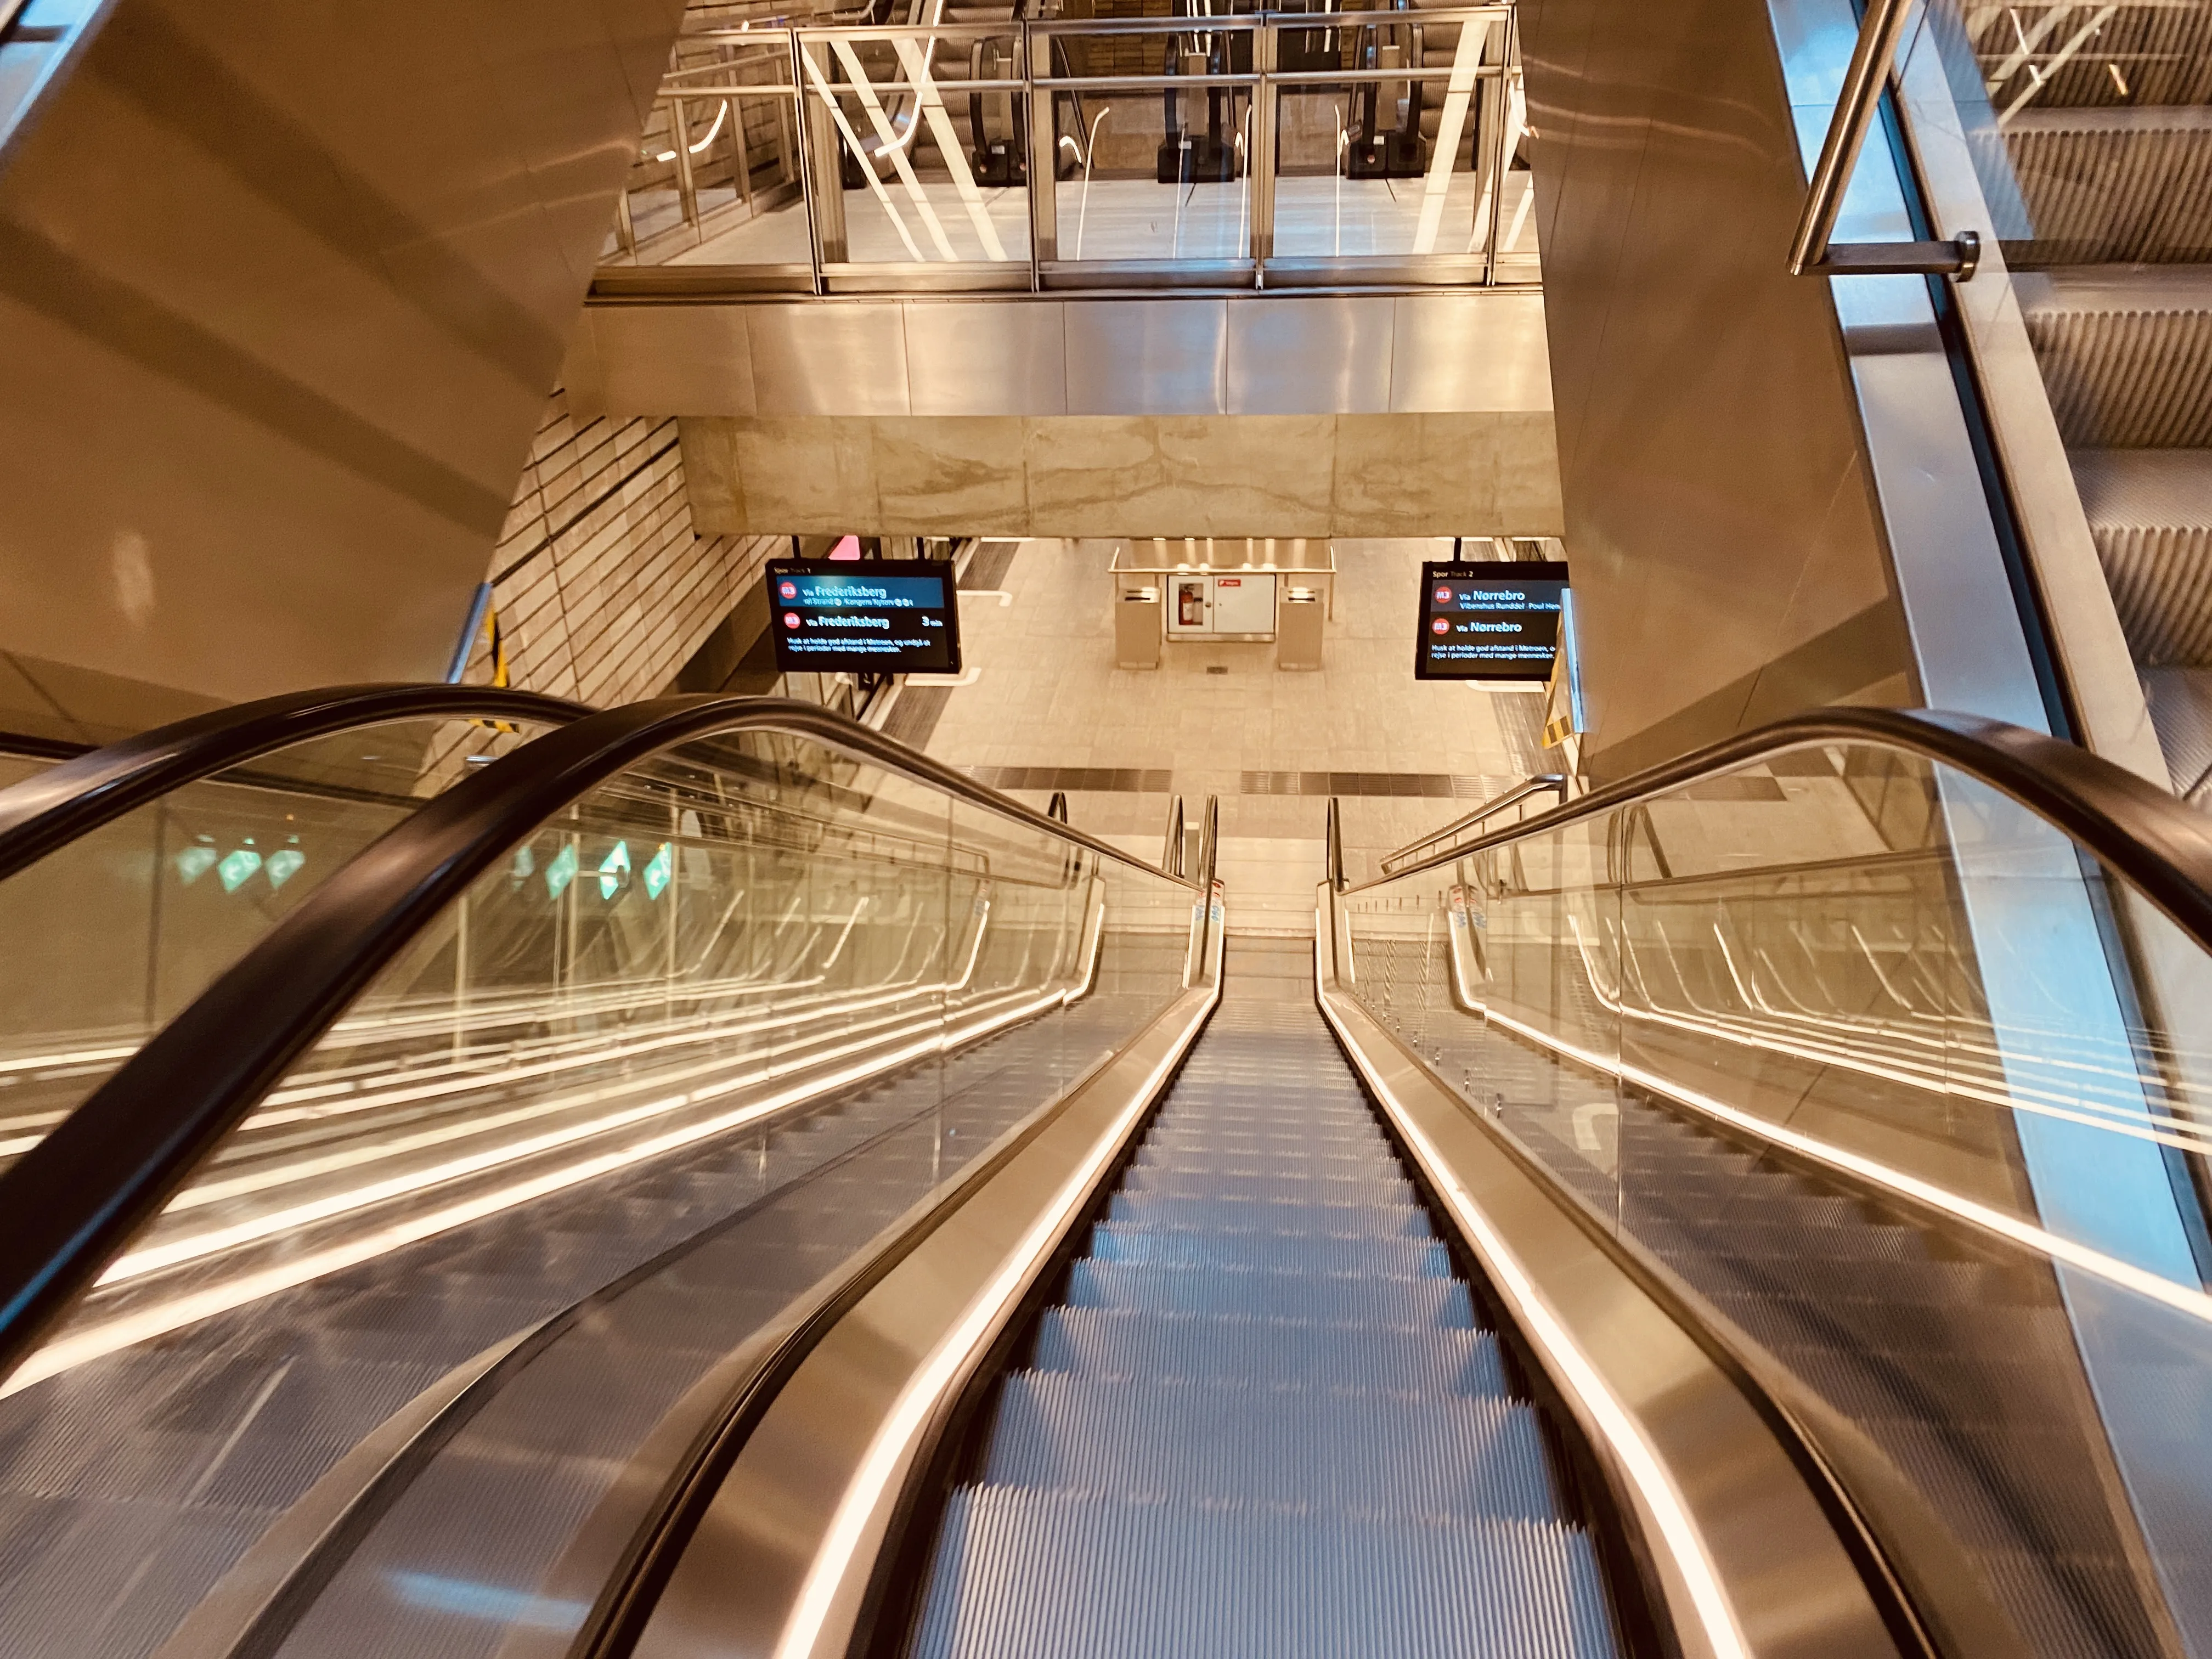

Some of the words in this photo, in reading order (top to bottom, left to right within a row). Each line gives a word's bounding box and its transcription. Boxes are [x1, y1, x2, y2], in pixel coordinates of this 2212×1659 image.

[815, 585, 887, 599] Frederiksberg
[1473, 590, 1525, 601] Nørrebro
[818, 616, 889, 629] Frederiksberg
[922, 616, 929, 627] 3
[1470, 622, 1522, 633] Nørrebro
